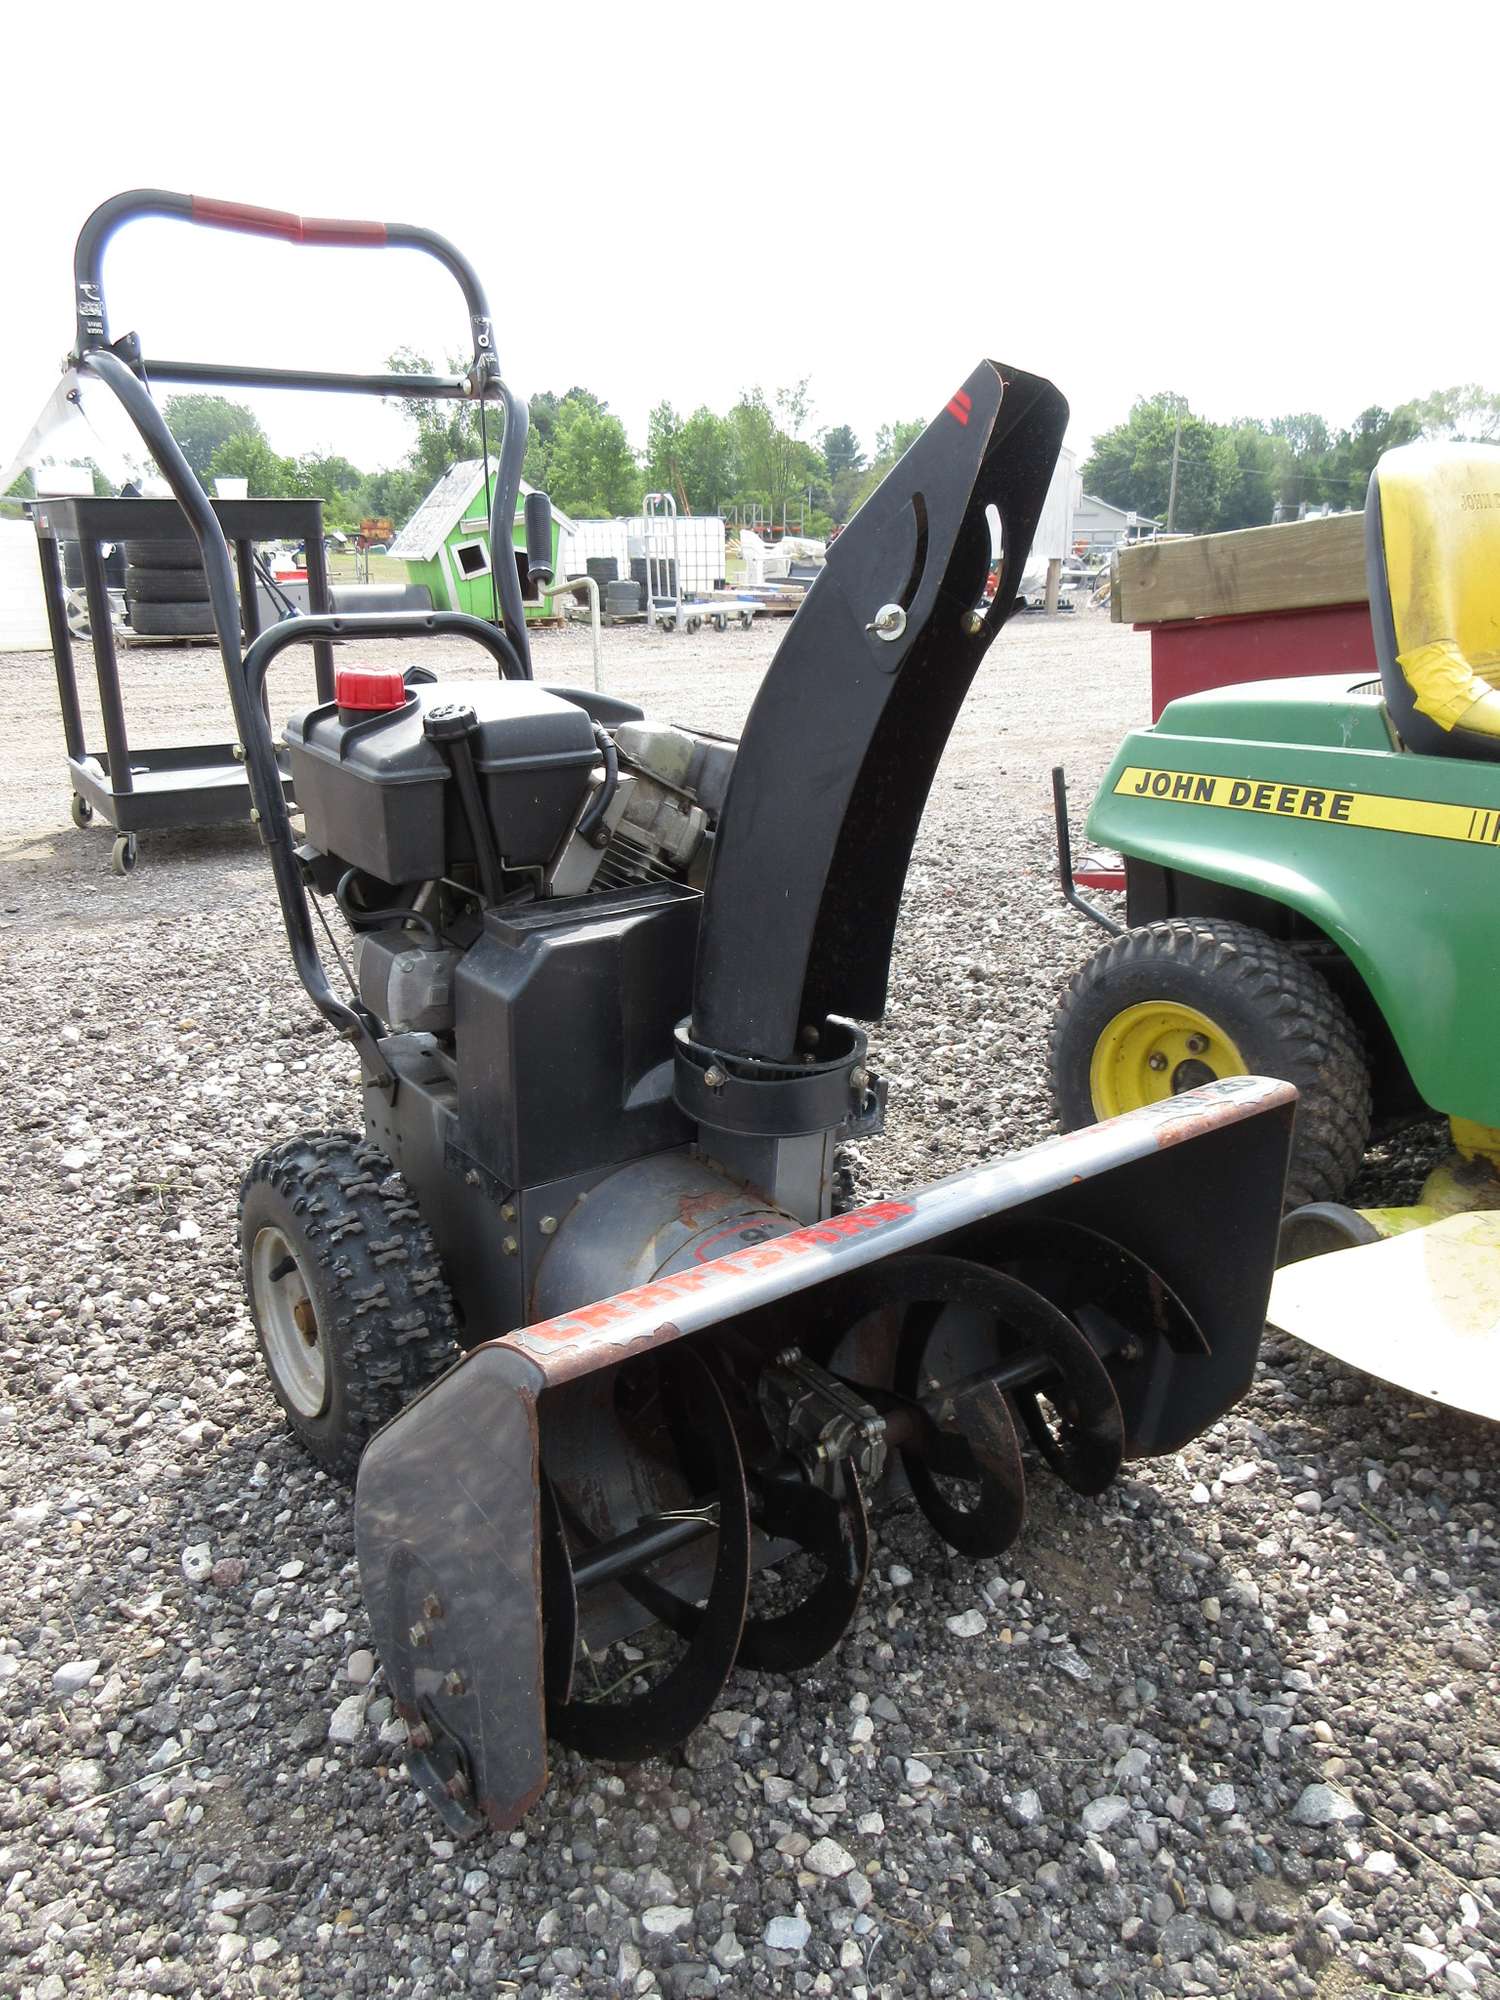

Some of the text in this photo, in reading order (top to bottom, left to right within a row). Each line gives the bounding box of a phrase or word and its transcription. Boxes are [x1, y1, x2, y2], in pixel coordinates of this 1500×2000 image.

[1134, 770, 1354, 822] JOHN DEERE
[525, 1200, 917, 1341] CRAFTSMAN
